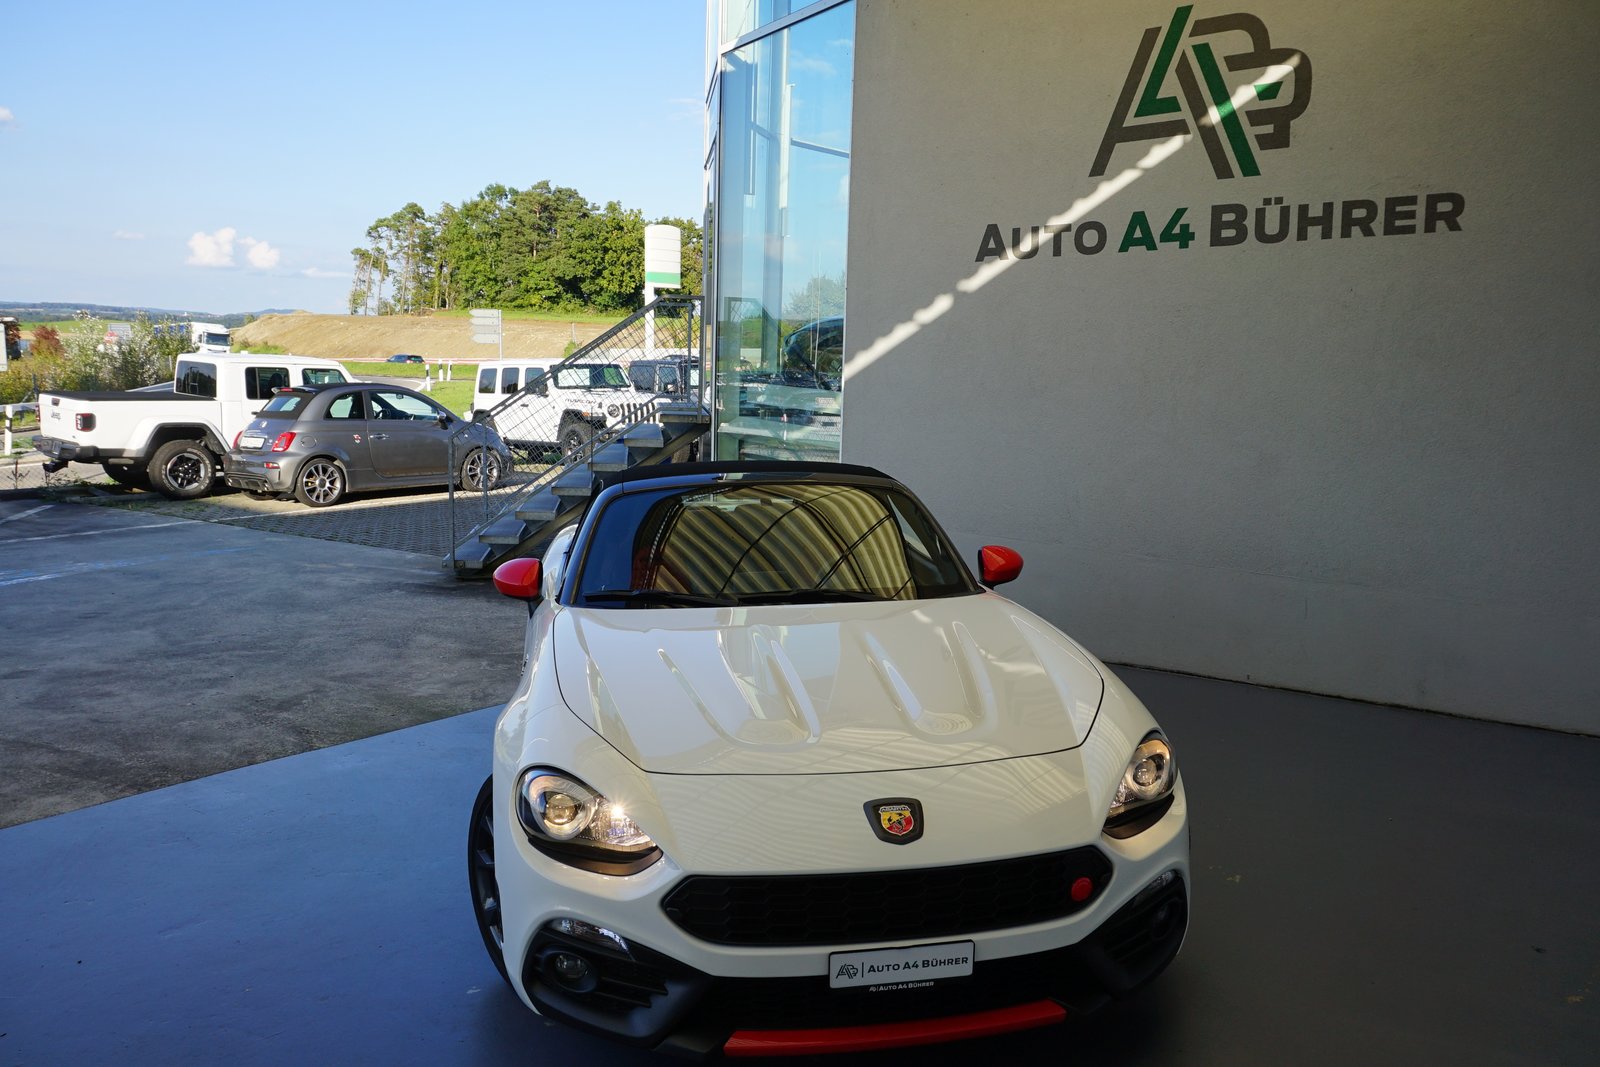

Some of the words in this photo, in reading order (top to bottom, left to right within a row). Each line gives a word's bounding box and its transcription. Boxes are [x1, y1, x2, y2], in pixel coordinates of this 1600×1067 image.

[974, 220, 1107, 263] AUTO
[1118, 207, 1195, 253] A4
[1209, 192, 1465, 248] BÜHRER
[867, 963, 900, 974] AUTO
[902, 960, 920, 971] A4
[922, 956, 969, 969] BÜHRER
[908, 981, 935, 989] BÜHRER
